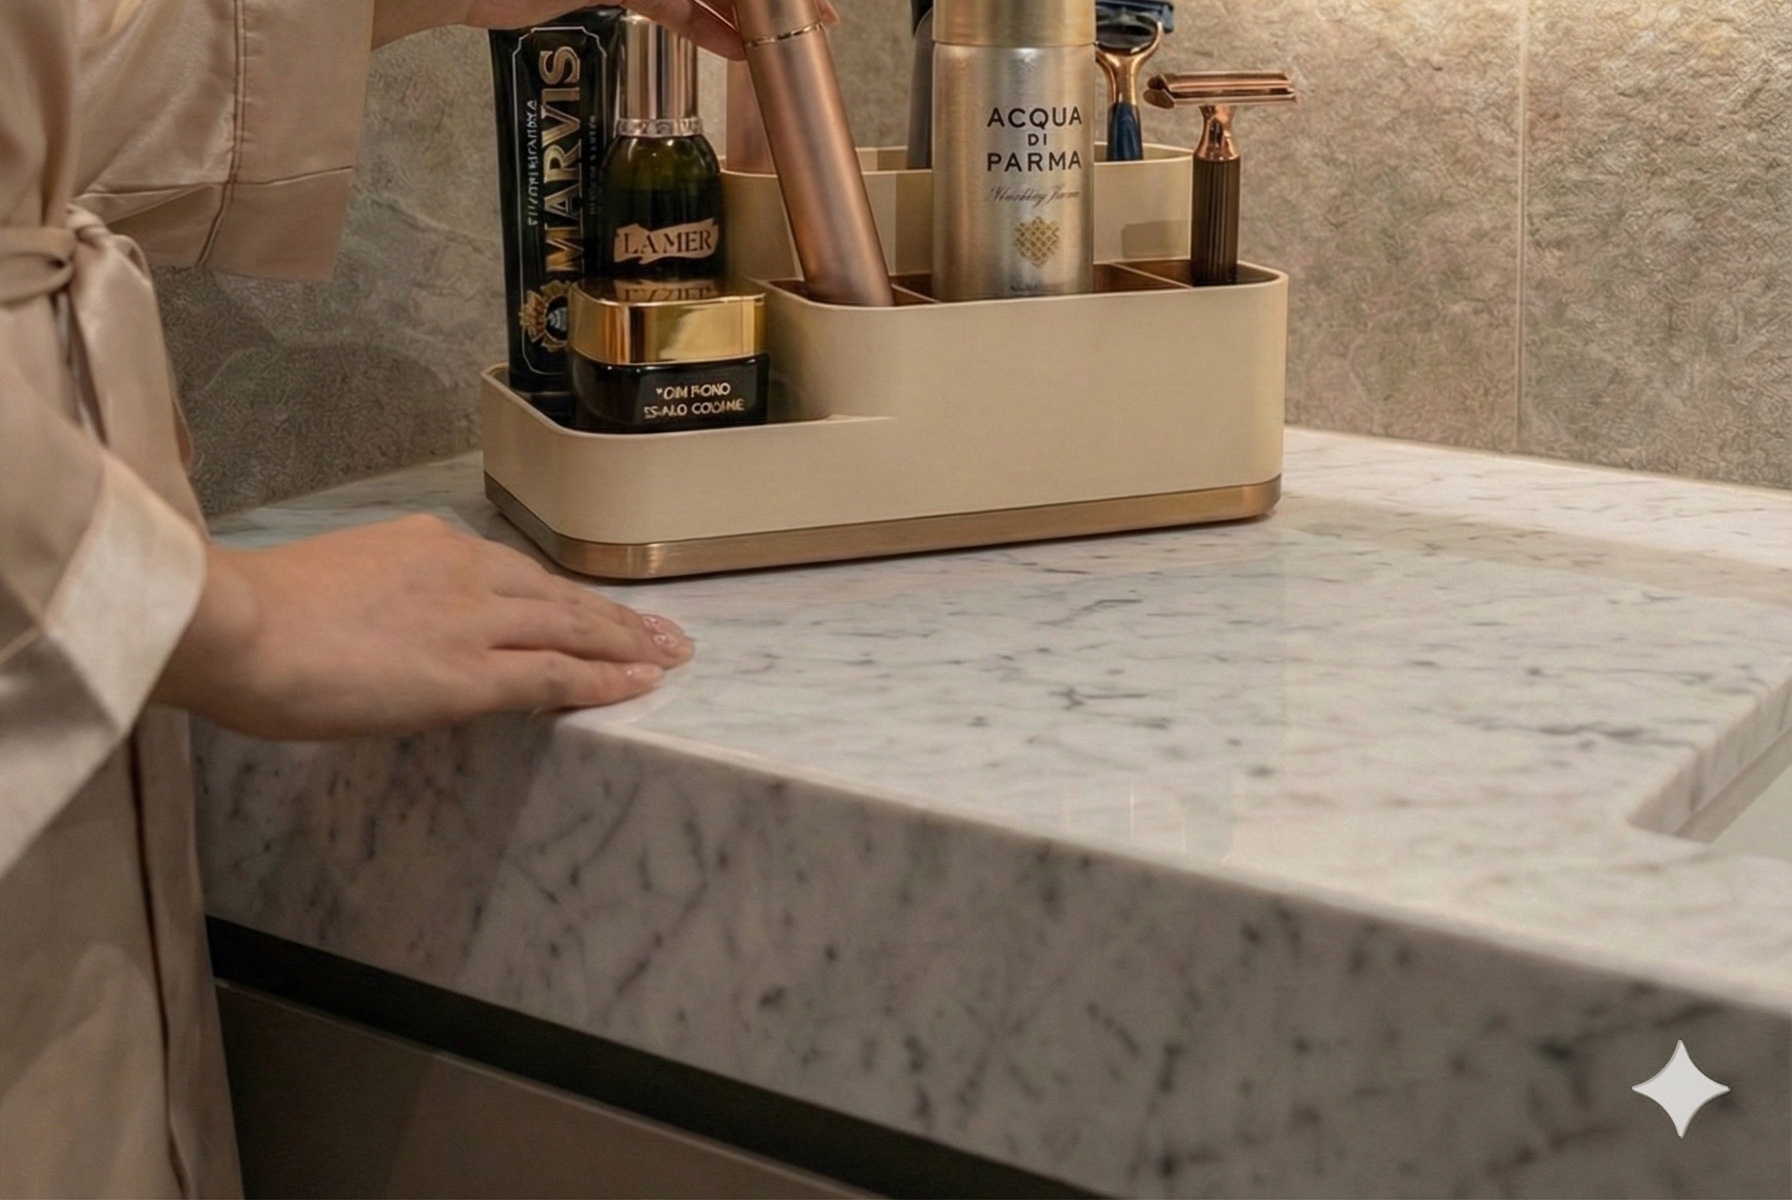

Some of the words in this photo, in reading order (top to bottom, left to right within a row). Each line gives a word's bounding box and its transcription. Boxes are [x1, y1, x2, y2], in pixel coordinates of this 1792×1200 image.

[987, 106, 1082, 130] ACQUA
[1028, 133, 1047, 146] DI
[539, 46, 584, 273] MARVIS
[987, 150, 1082, 172] PARMA
